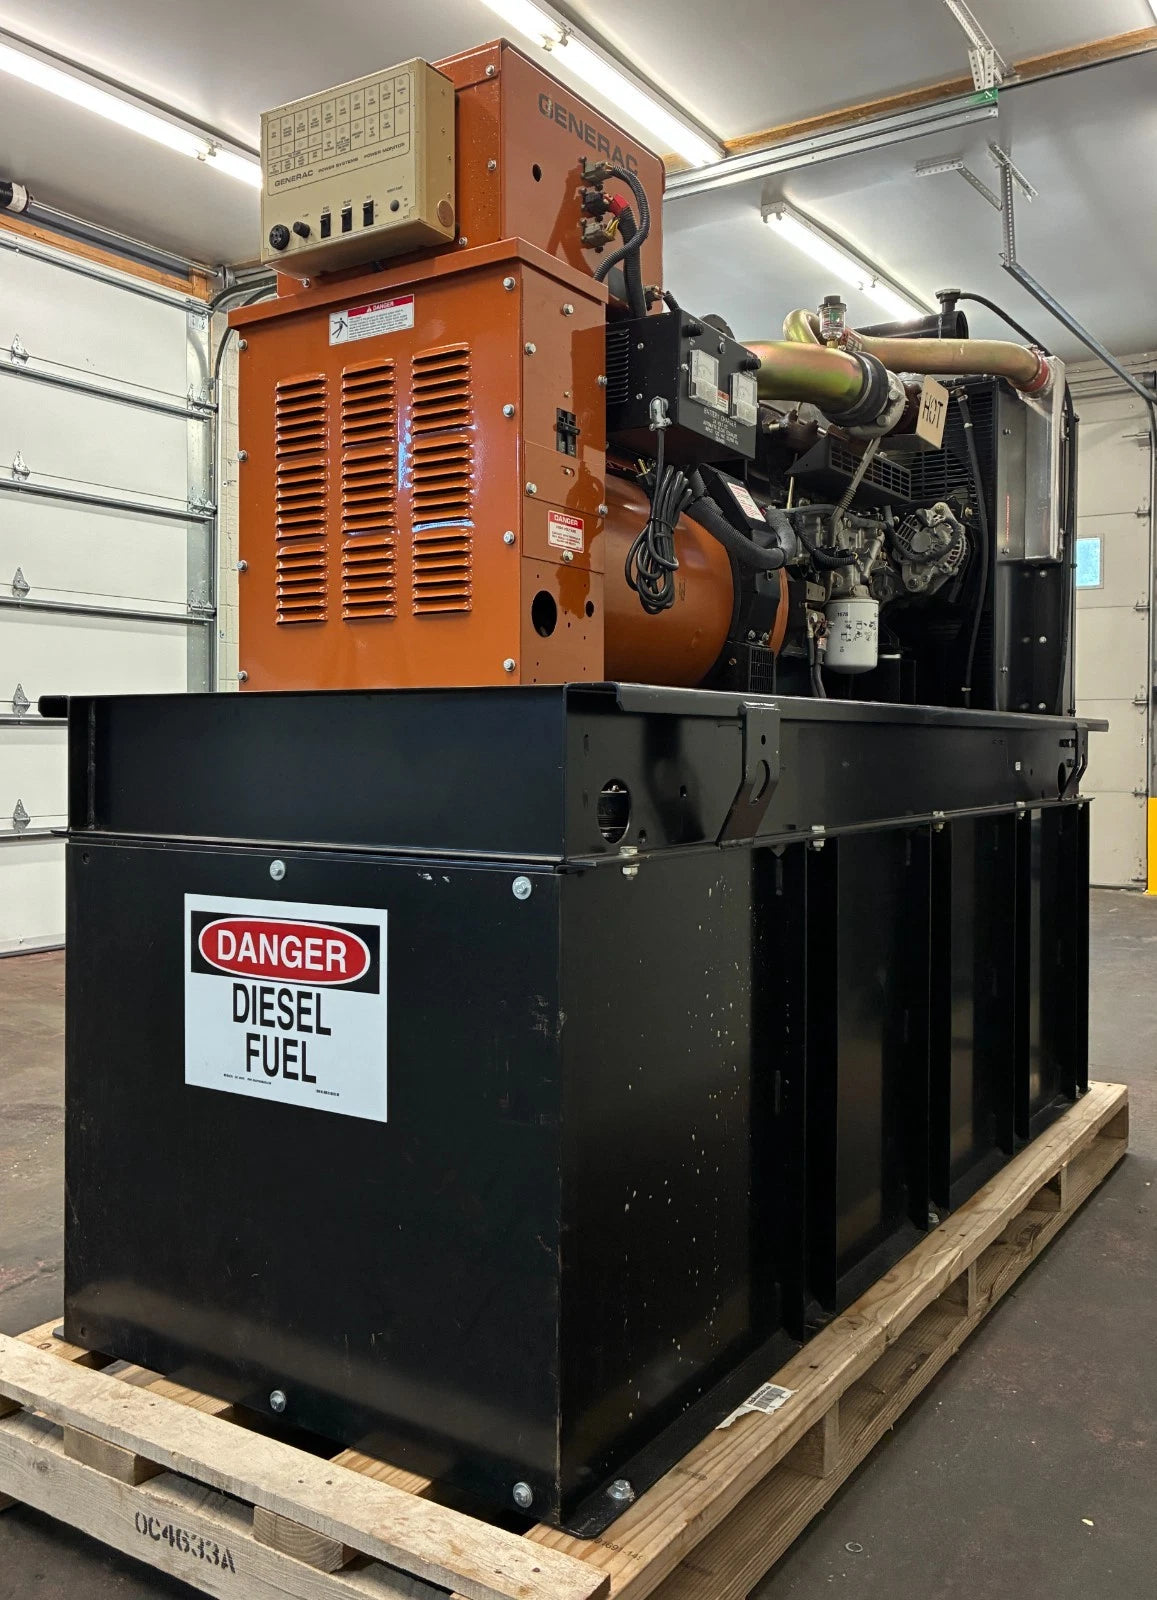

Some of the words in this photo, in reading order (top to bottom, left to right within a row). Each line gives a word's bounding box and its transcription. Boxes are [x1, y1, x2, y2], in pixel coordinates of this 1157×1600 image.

[538, 93, 638, 174] GENERAC
[274, 169, 314, 187] GENERAC
[318, 165, 335, 173] POWER
[363, 150, 382, 159] POWER
[382, 142, 406, 153] MONITOR
[372, 300, 394, 312] DANGER
[923, 392, 943, 428] HOT
[554, 514, 578, 526] DANGER
[217, 929, 347, 973] DANGER
[232, 982, 332, 1036] DIESEL
[246, 1032, 317, 1084] FUEL
